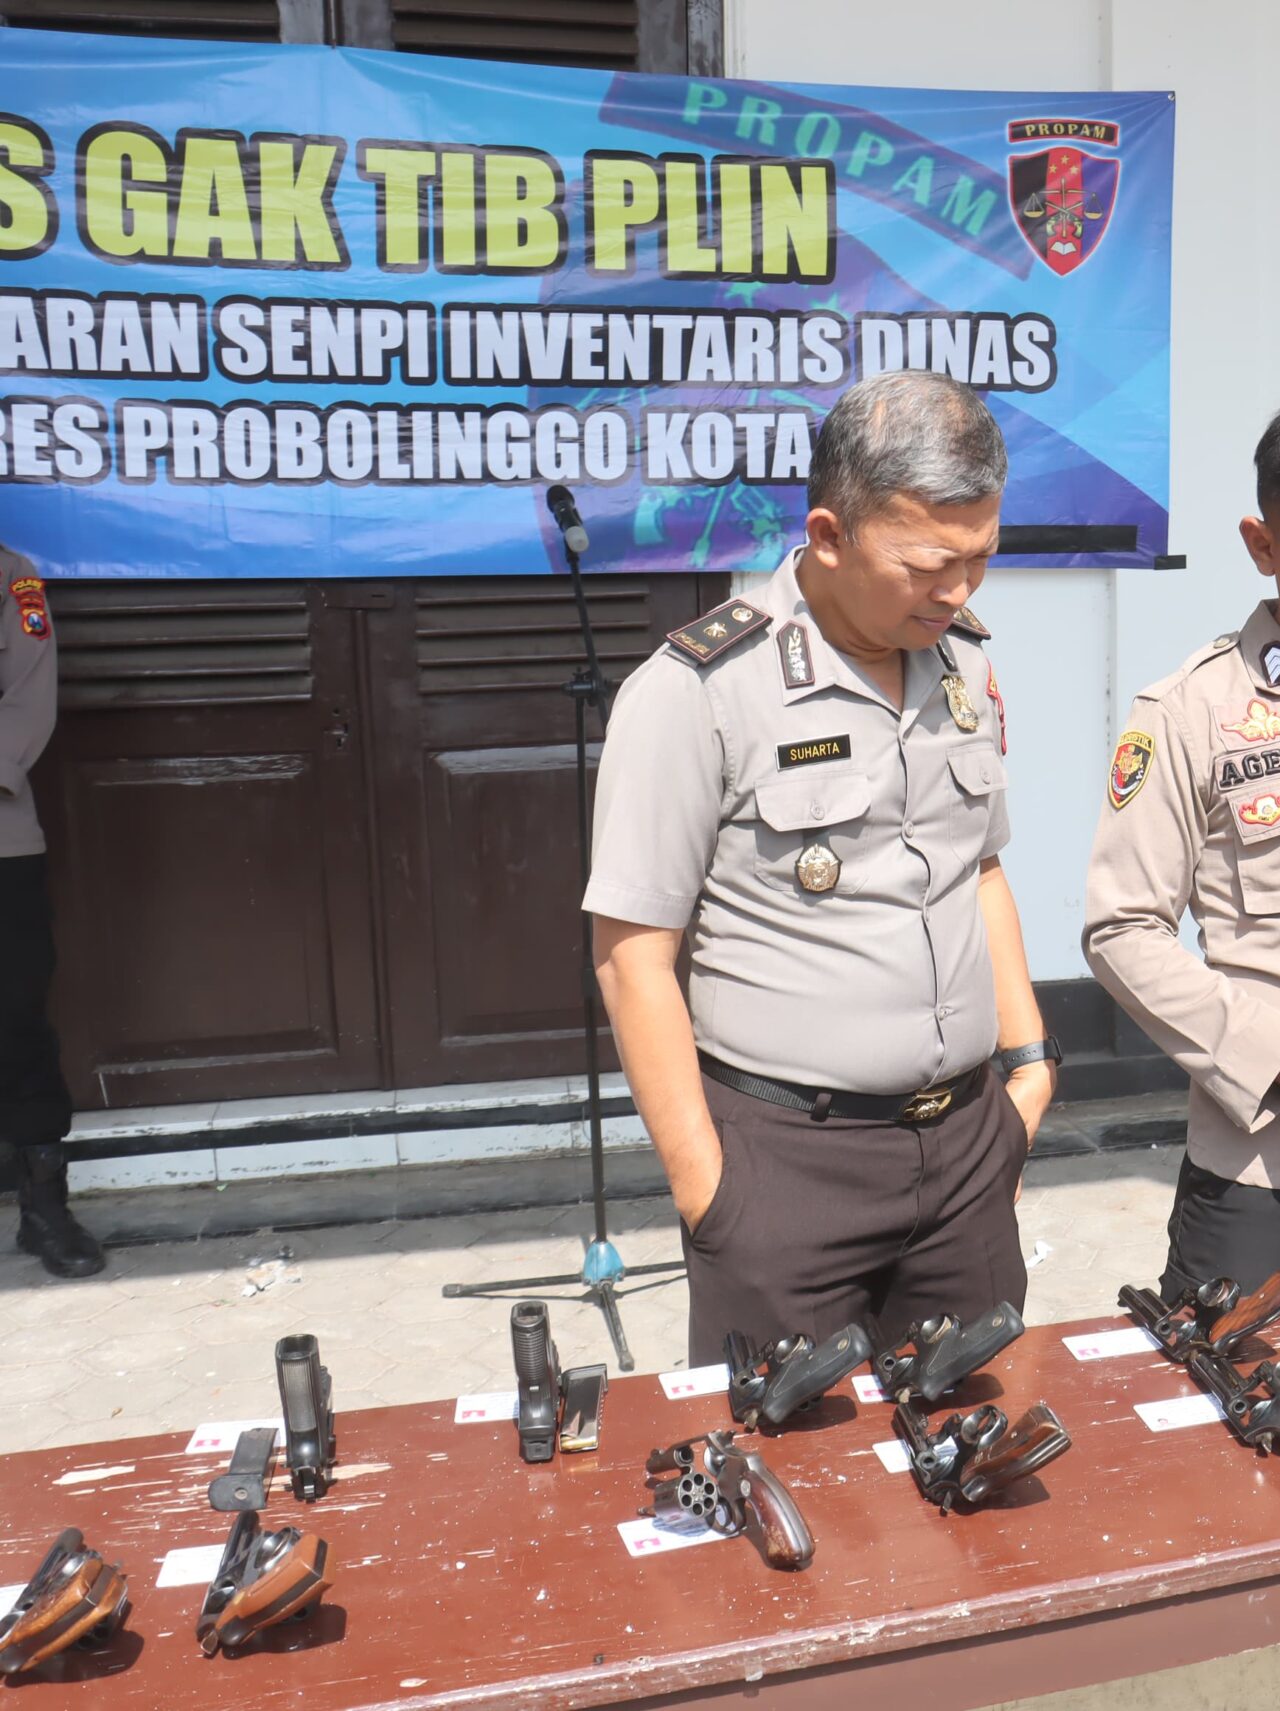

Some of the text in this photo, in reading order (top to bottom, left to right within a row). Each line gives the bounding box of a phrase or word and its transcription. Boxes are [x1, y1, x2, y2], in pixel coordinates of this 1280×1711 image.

[682, 82, 997, 237] PROPAM
[1024, 123, 1106, 139] PROPAM
[84, 129, 344, 265] GAK
[365, 147, 560, 269] TIB
[591, 157, 829, 277] PLIN
[219, 302, 430, 379] SENPI
[450, 310, 842, 384] INVENTARIS
[861, 318, 1052, 387] DINAS
[0, 403, 811, 481] ES PROBOLINGGO KOTA
[789, 741, 840, 761] SUHARTA
